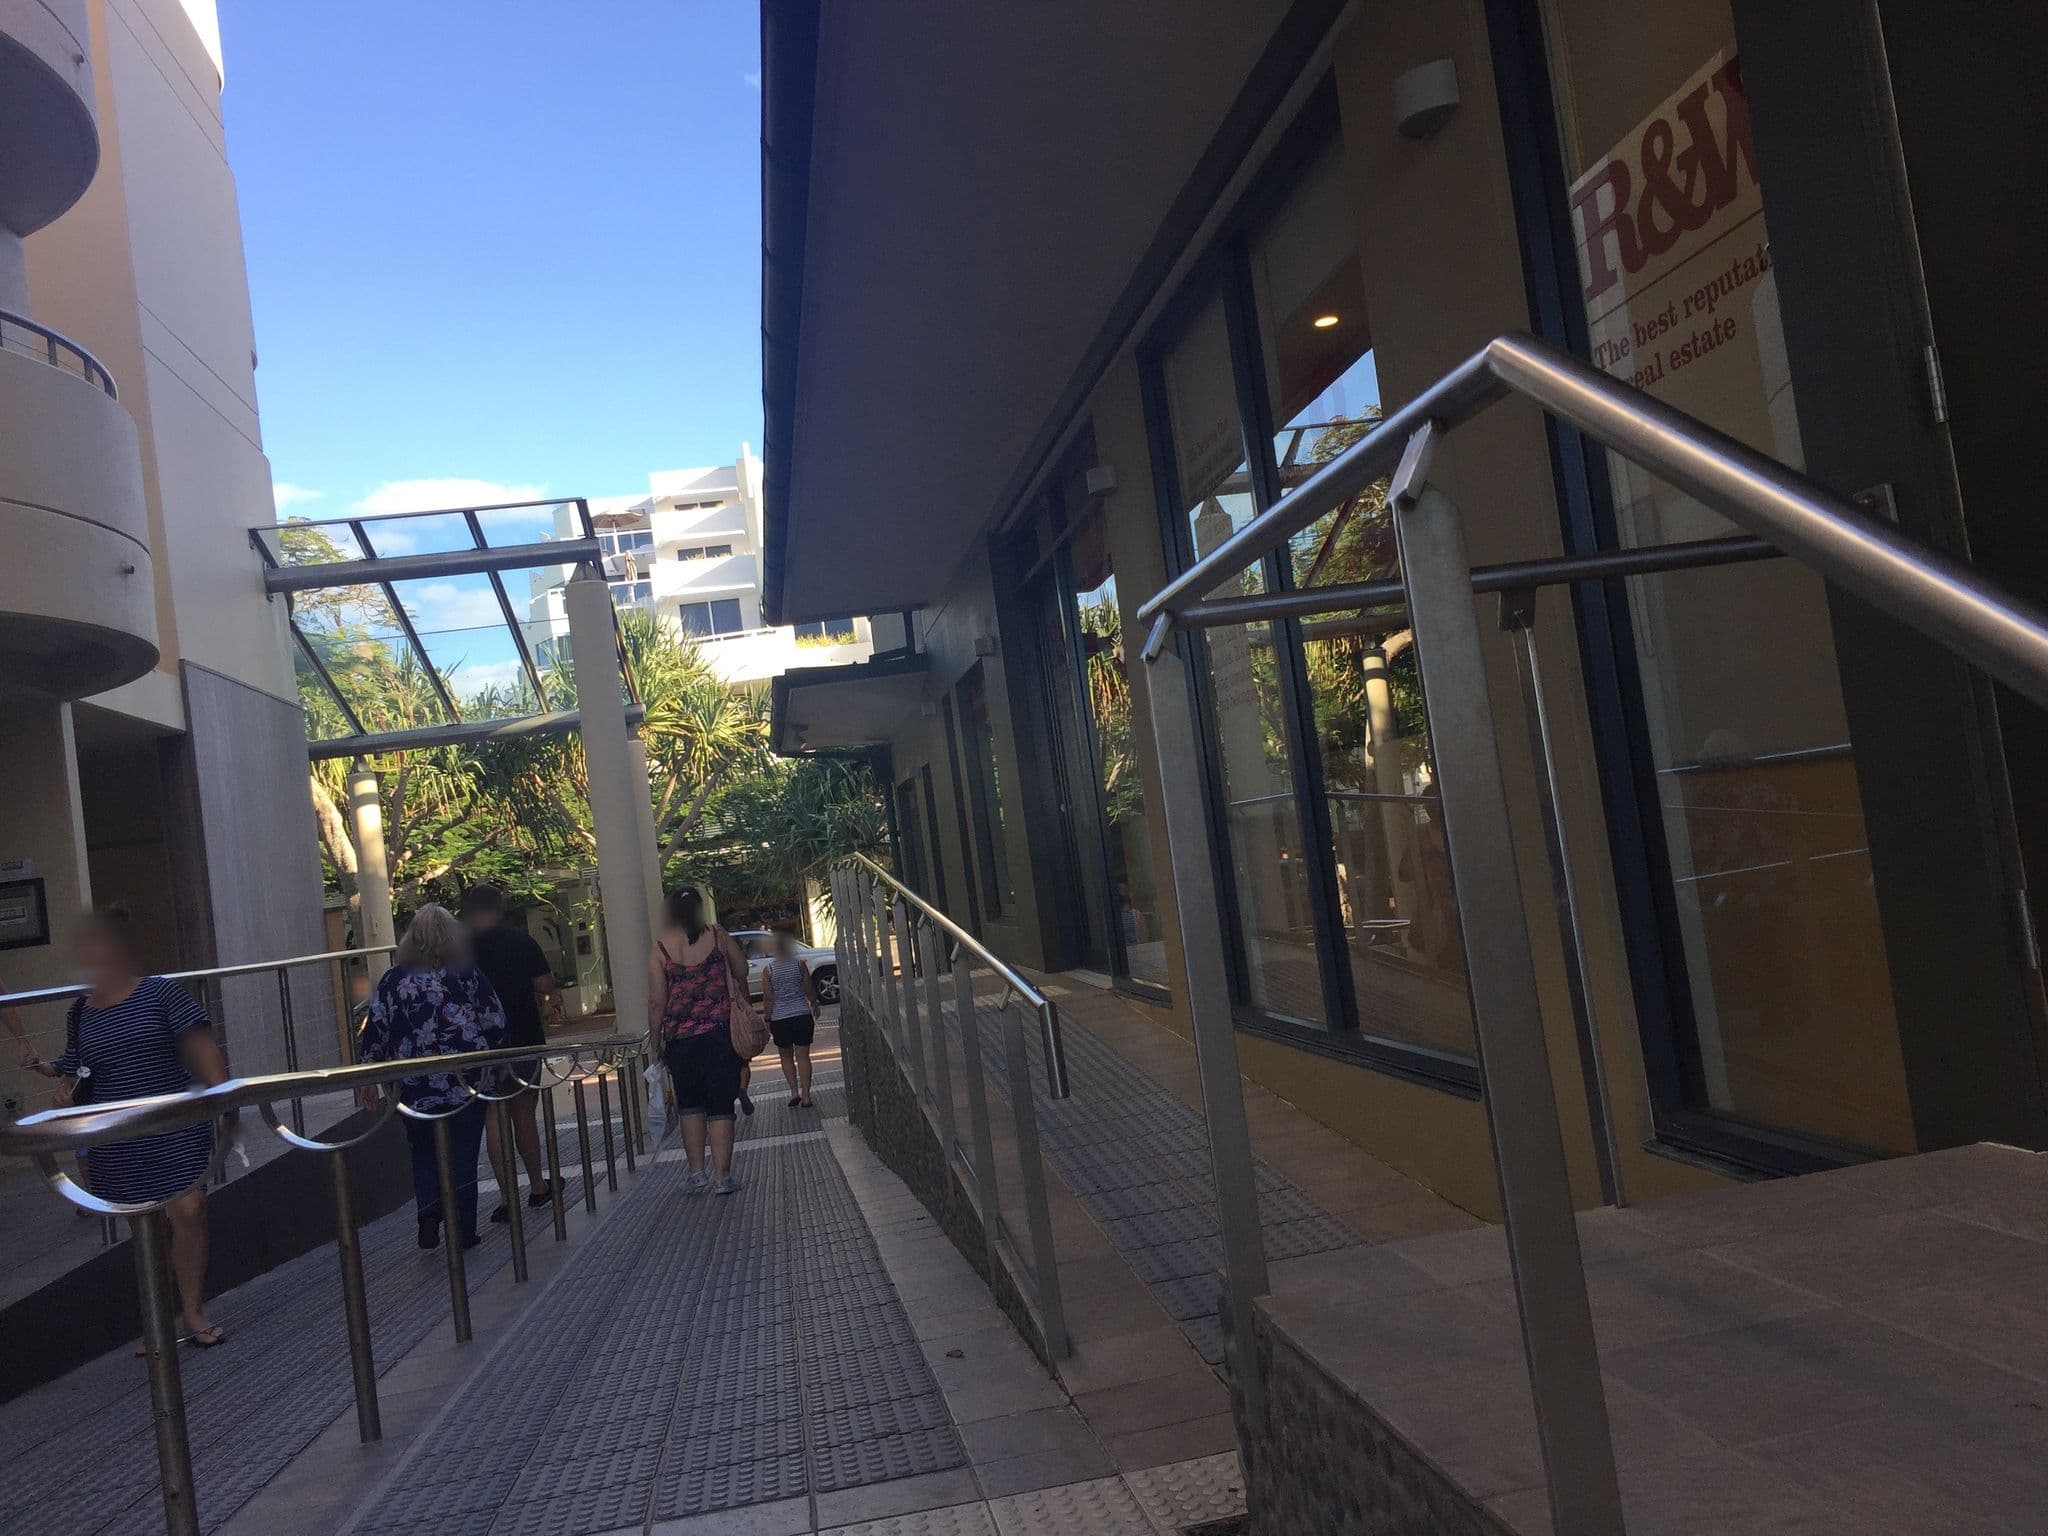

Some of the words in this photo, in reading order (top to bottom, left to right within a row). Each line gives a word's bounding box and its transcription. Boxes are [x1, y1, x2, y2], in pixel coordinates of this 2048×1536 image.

[1594, 336, 1631, 369] The
[1633, 300, 1678, 348] best
[1683, 243, 1772, 319] reputat
[1670, 315, 1737, 370] estate
